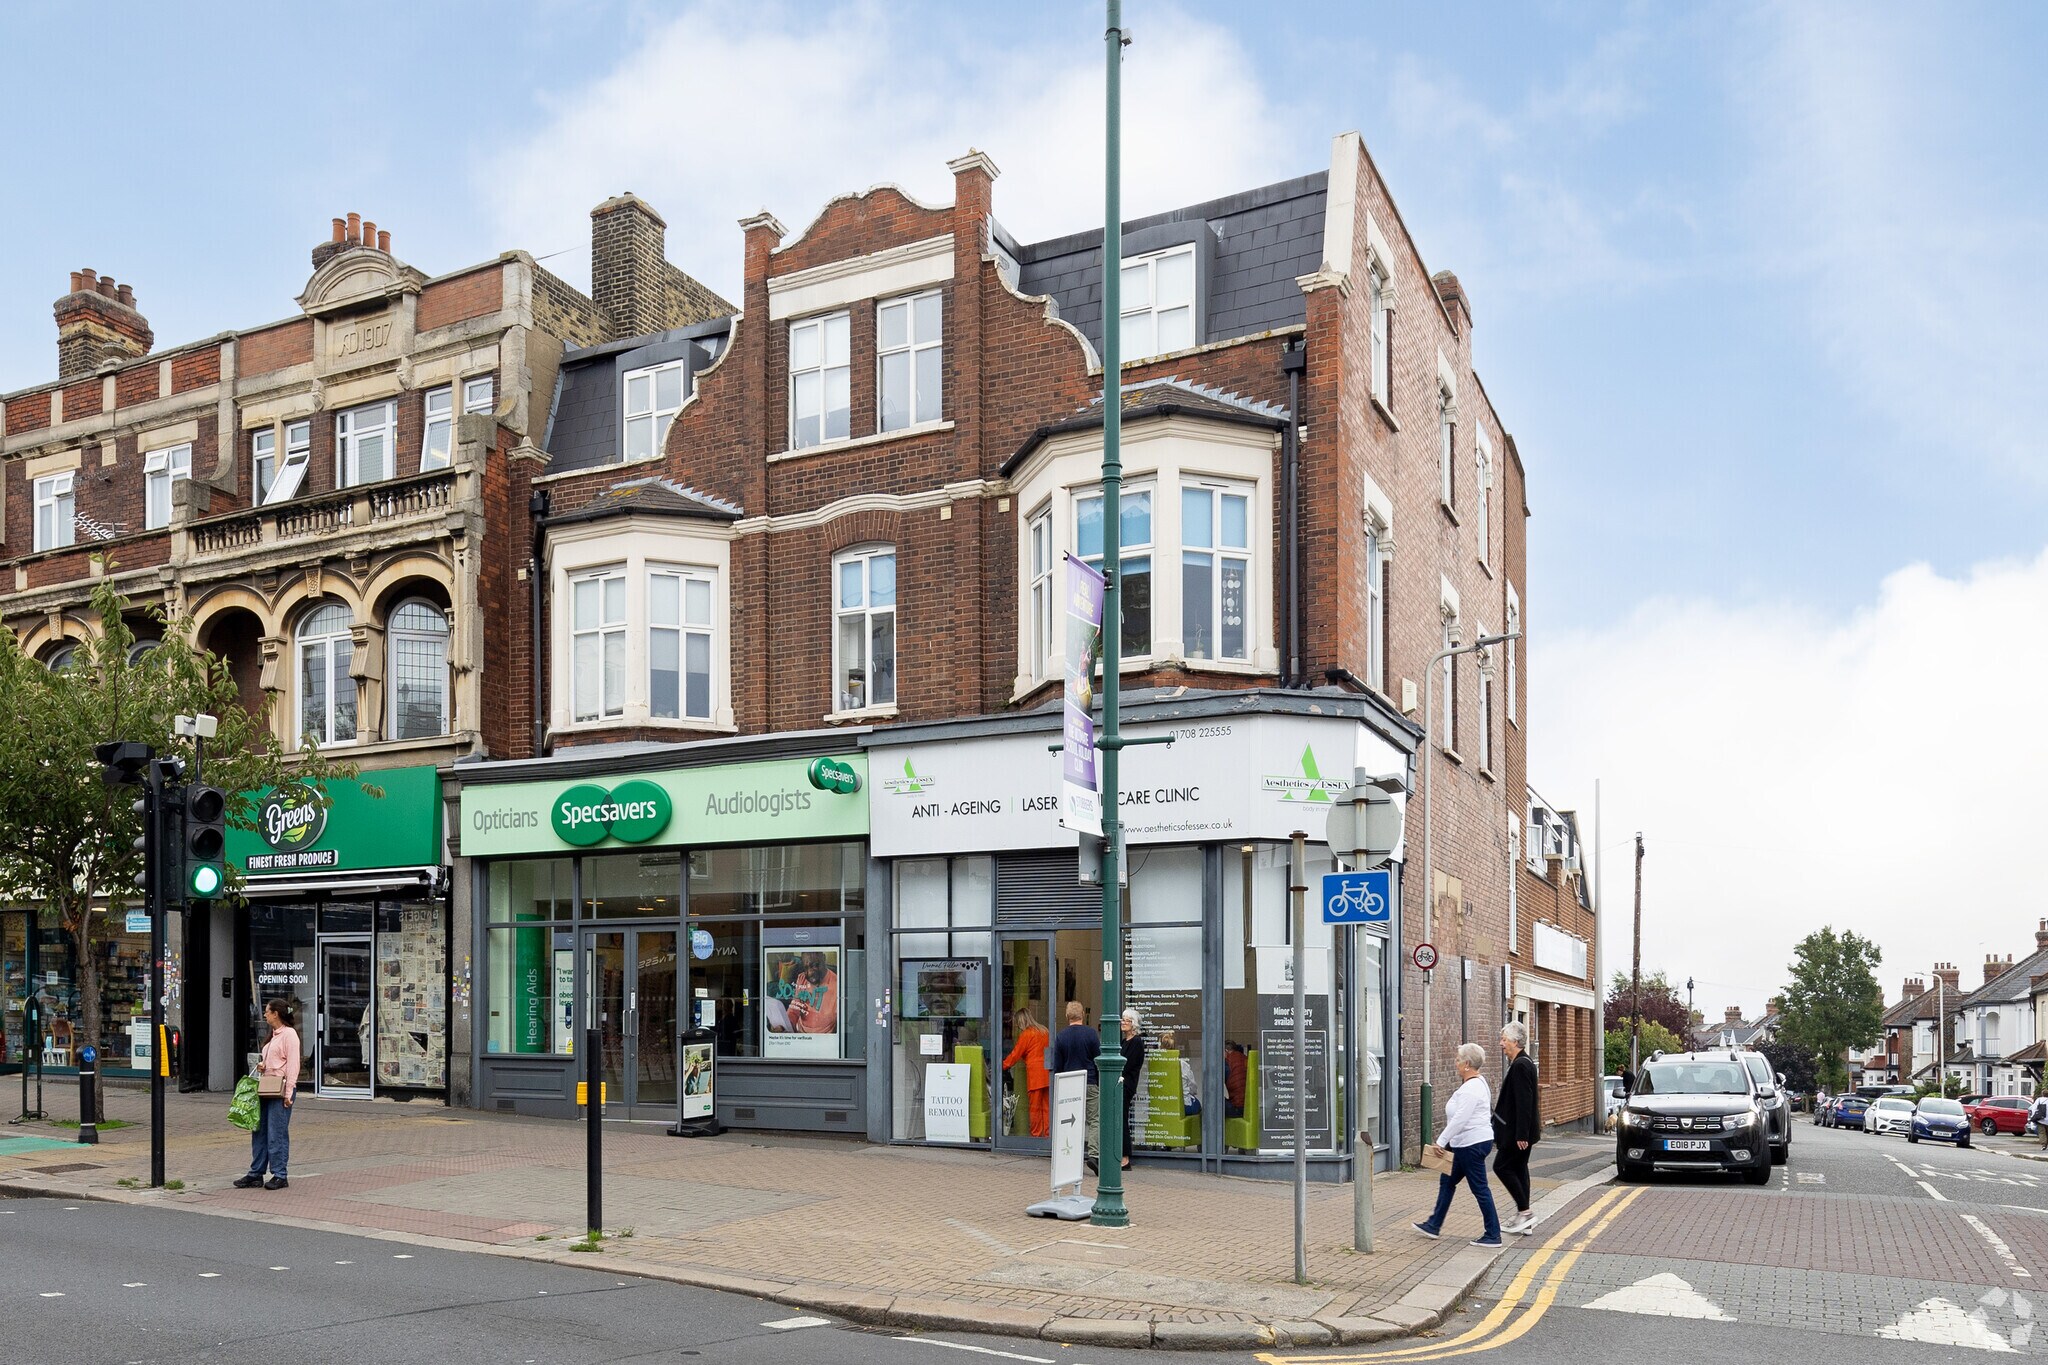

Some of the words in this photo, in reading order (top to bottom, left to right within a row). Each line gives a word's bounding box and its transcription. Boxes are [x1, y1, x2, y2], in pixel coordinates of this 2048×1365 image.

[1169, 728, 1196, 739] 01708
[1198, 725, 1232, 738] 225555
[821, 764, 854, 784] Specsavers
[1264, 778, 1310, 788] Aesthetics
[1321, 780, 1351, 790] ESSEX
[911, 803, 940, 818] ANTI
[951, 799, 1001, 816] AGEING
[1022, 796, 1058, 812] LASER
[1118, 789, 1151, 806] CARE
[1155, 786, 1200, 804] CLINIC
[473, 807, 538, 835] Opticians
[561, 800, 657, 829] Specsavers
[705, 788, 811, 817] Audiologists
[266, 801, 315, 844] Greens
[1124, 818, 1233, 833] www.aestheticsofessex.co.uk
[248, 856, 273, 869] FINEST
[274, 853, 297, 867] FRESH
[298, 851, 332, 866] PRODUCE
[694, 933, 708, 945] Big
[263, 962, 288, 970] STATION
[288, 962, 305, 970] SHOP
[258, 974, 288, 984] OPENING
[288, 974, 309, 984] SOON
[526, 968, 538, 994] Aids
[1273, 1007, 1290, 1016] Minor
[526, 997, 540, 1046] Hearing
[931, 1095, 963, 1105] TATTOO
[928, 1108, 965, 1117] REMOVAL
[1690, 1140, 1707, 1149] PJX
